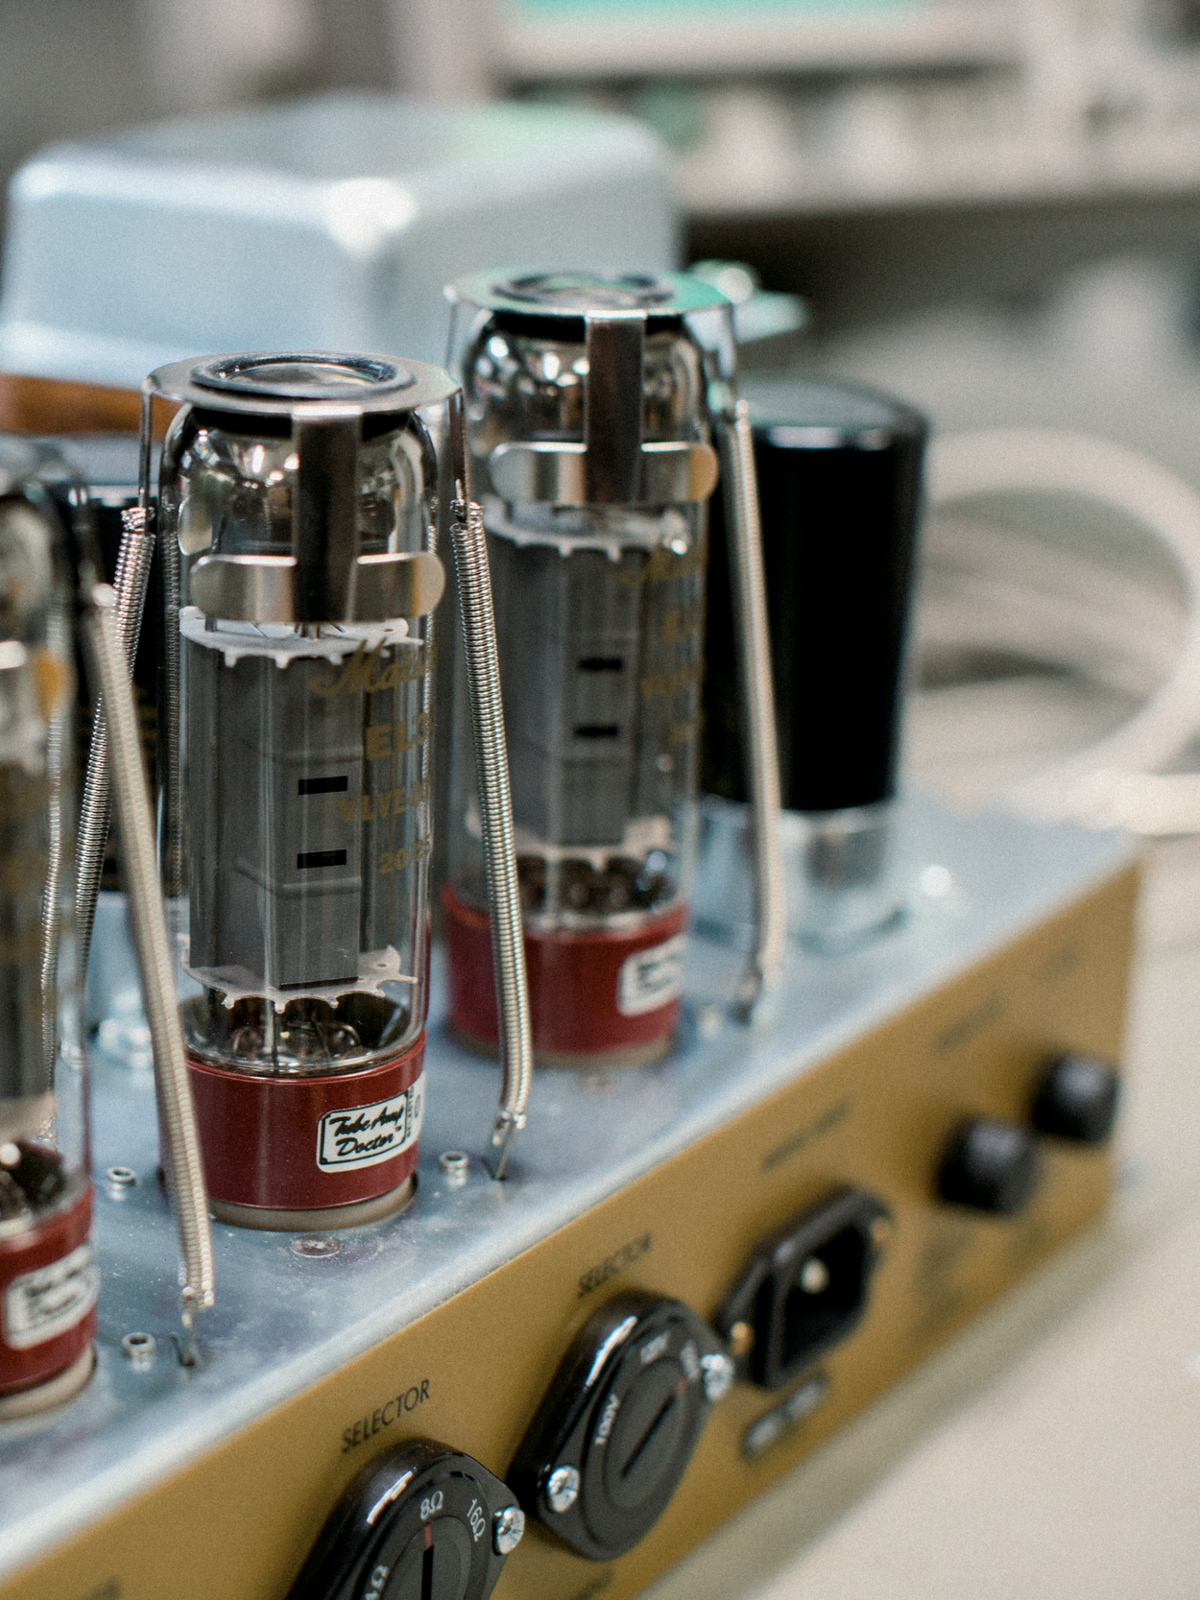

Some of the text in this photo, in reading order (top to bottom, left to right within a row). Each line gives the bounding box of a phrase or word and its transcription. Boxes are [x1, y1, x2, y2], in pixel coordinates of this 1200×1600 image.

[329, 1112, 371, 1137] Tube
[335, 1132, 394, 1157] Doctor
[342, 1378, 431, 1453] SELECTOR
